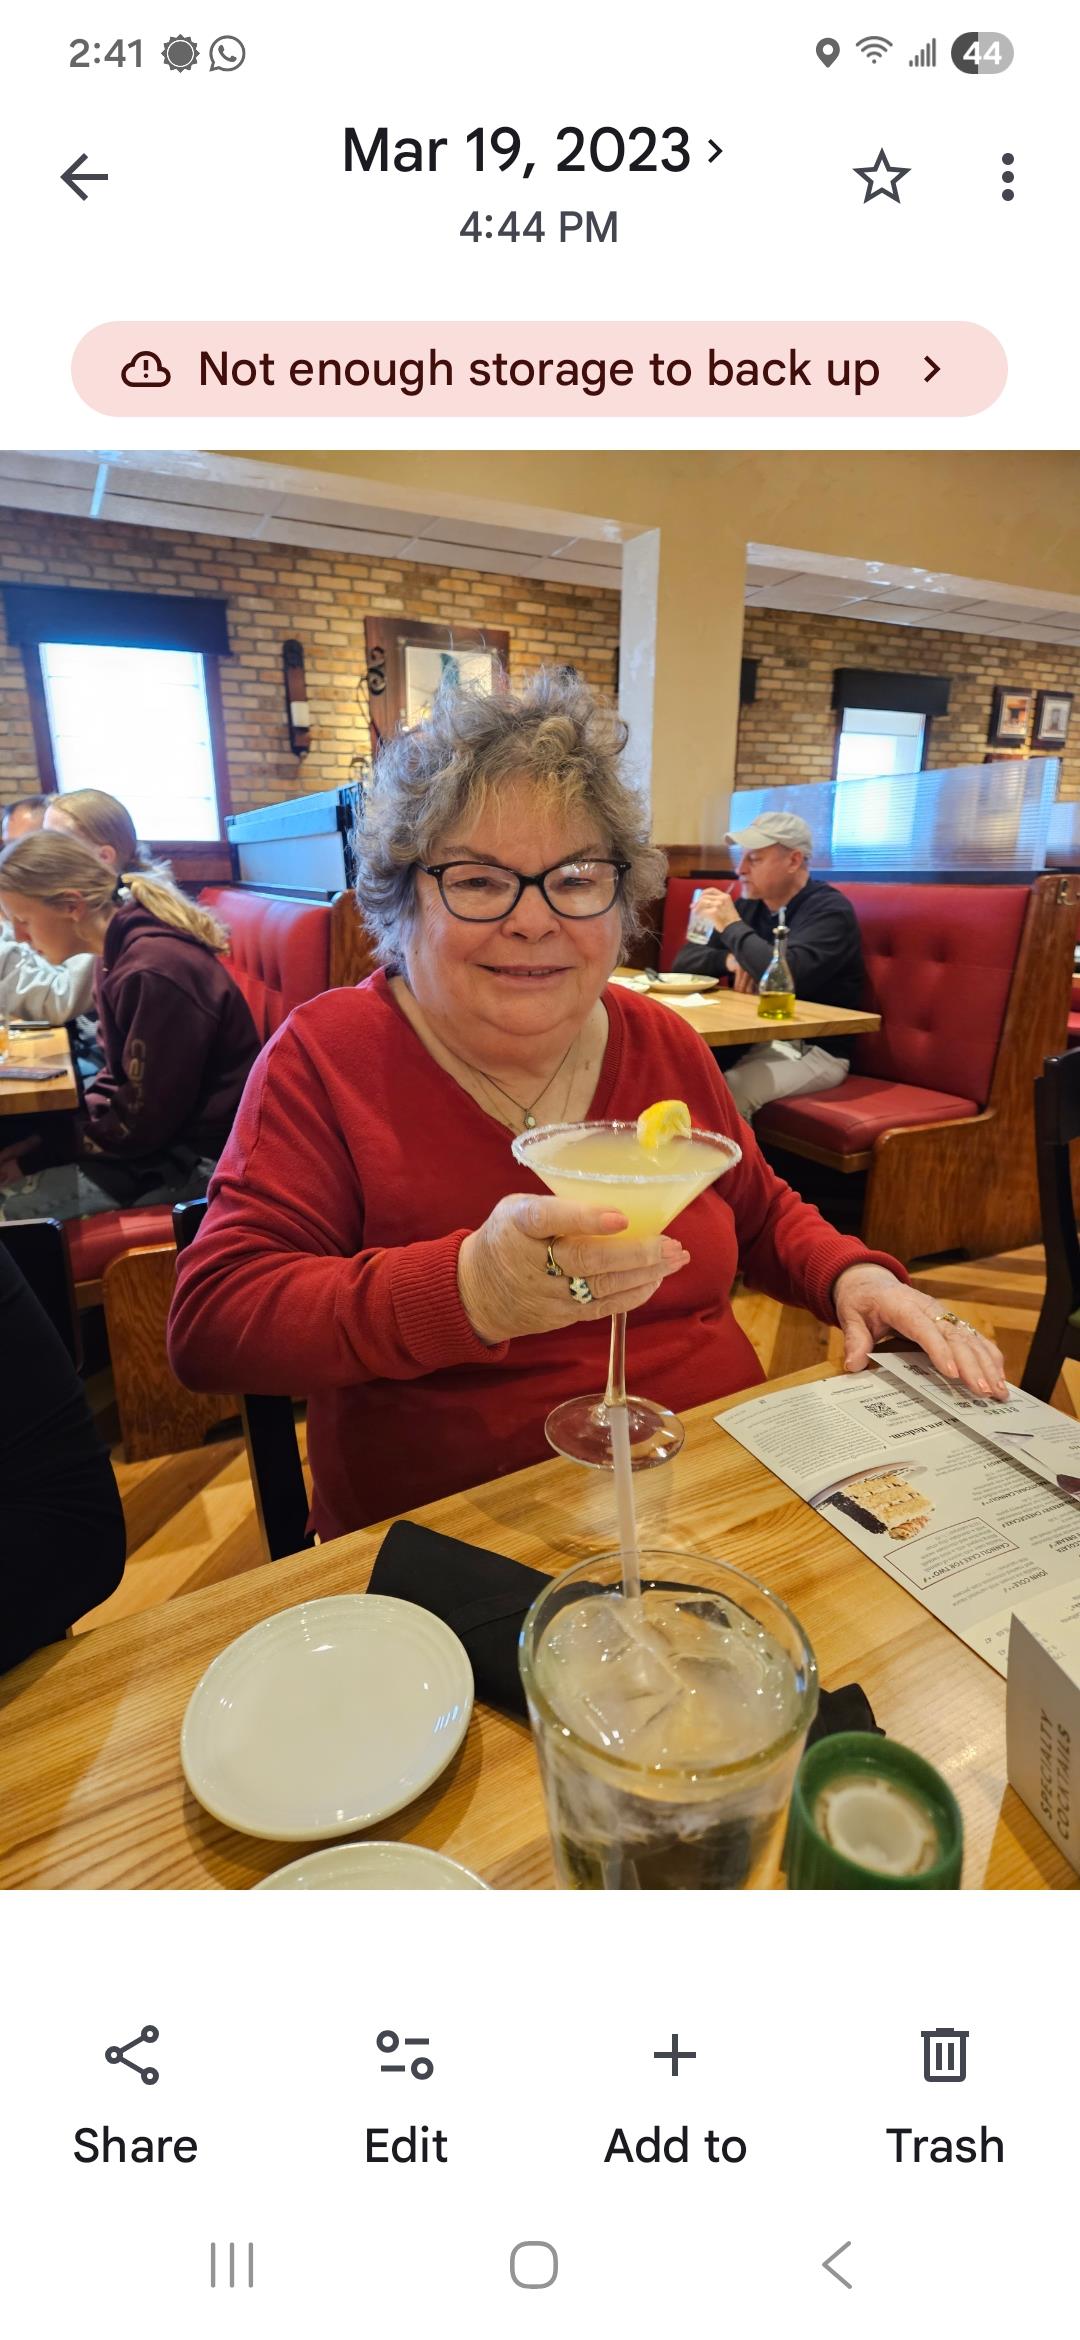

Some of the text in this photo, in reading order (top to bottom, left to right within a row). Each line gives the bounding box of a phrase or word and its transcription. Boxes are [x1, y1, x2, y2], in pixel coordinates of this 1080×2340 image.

[69, 38, 142, 69] 2:41
[963, 41, 1002, 65] 44
[345, 126, 690, 179] Mar 19, 2023
[460, 210, 618, 244] 4:44 PM
[201, 348, 879, 397] Not enough storage to back up
[889, 1425, 928, 1440] Redeem.
[950, 1559, 963, 1569] FOR
[963, 1553, 981, 1564] CAKE
[979, 1542, 1010, 1558] CANNOLI
[1031, 1570, 1048, 1582] JOHN
[1040, 1708, 1053, 1820] SPECIALTY
[1056, 1723, 1071, 1840] COCKTAILS
[74, 2125, 199, 2164] Share
[366, 2122, 448, 2164] Edit
[603, 2125, 746, 2164] Add to
[886, 2125, 1004, 2164] Trash
